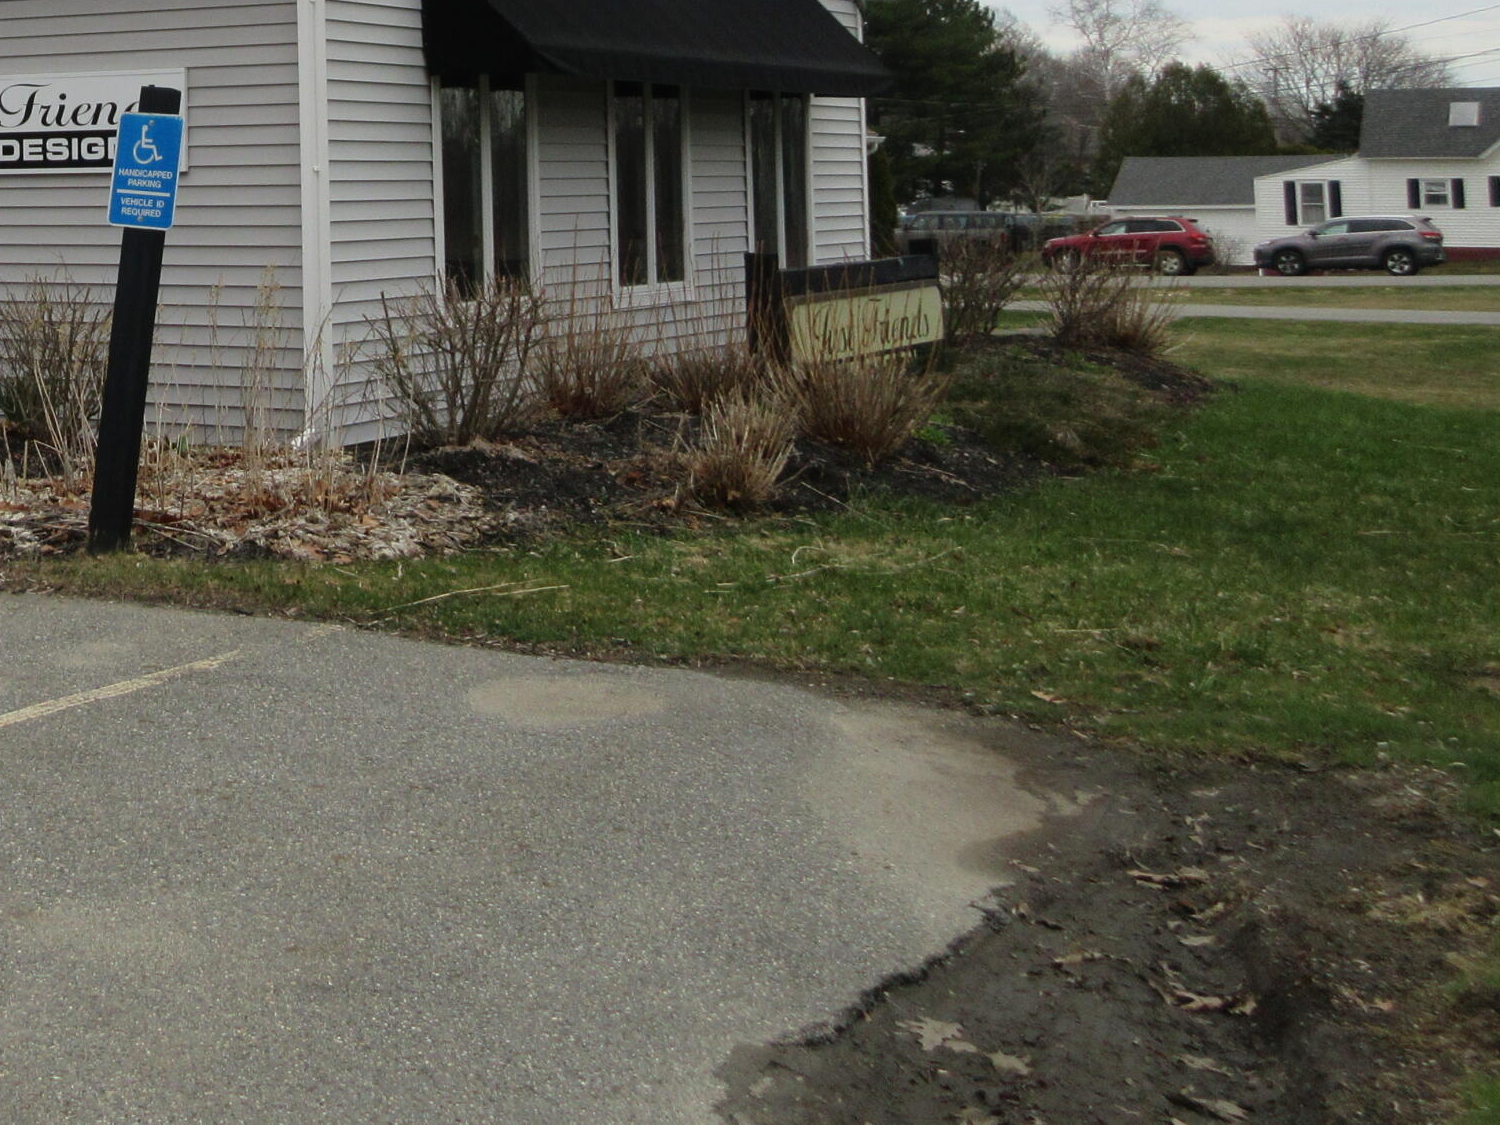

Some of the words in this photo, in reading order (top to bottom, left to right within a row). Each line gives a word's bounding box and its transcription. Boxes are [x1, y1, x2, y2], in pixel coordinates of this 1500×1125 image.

[118, 168, 173, 179] HANDICAPPED
[127, 178, 162, 188] PARKING
[120, 197, 153, 208] VEHICLE
[156, 199, 164, 208] ID
[121, 208, 162, 218] REQUIRED
